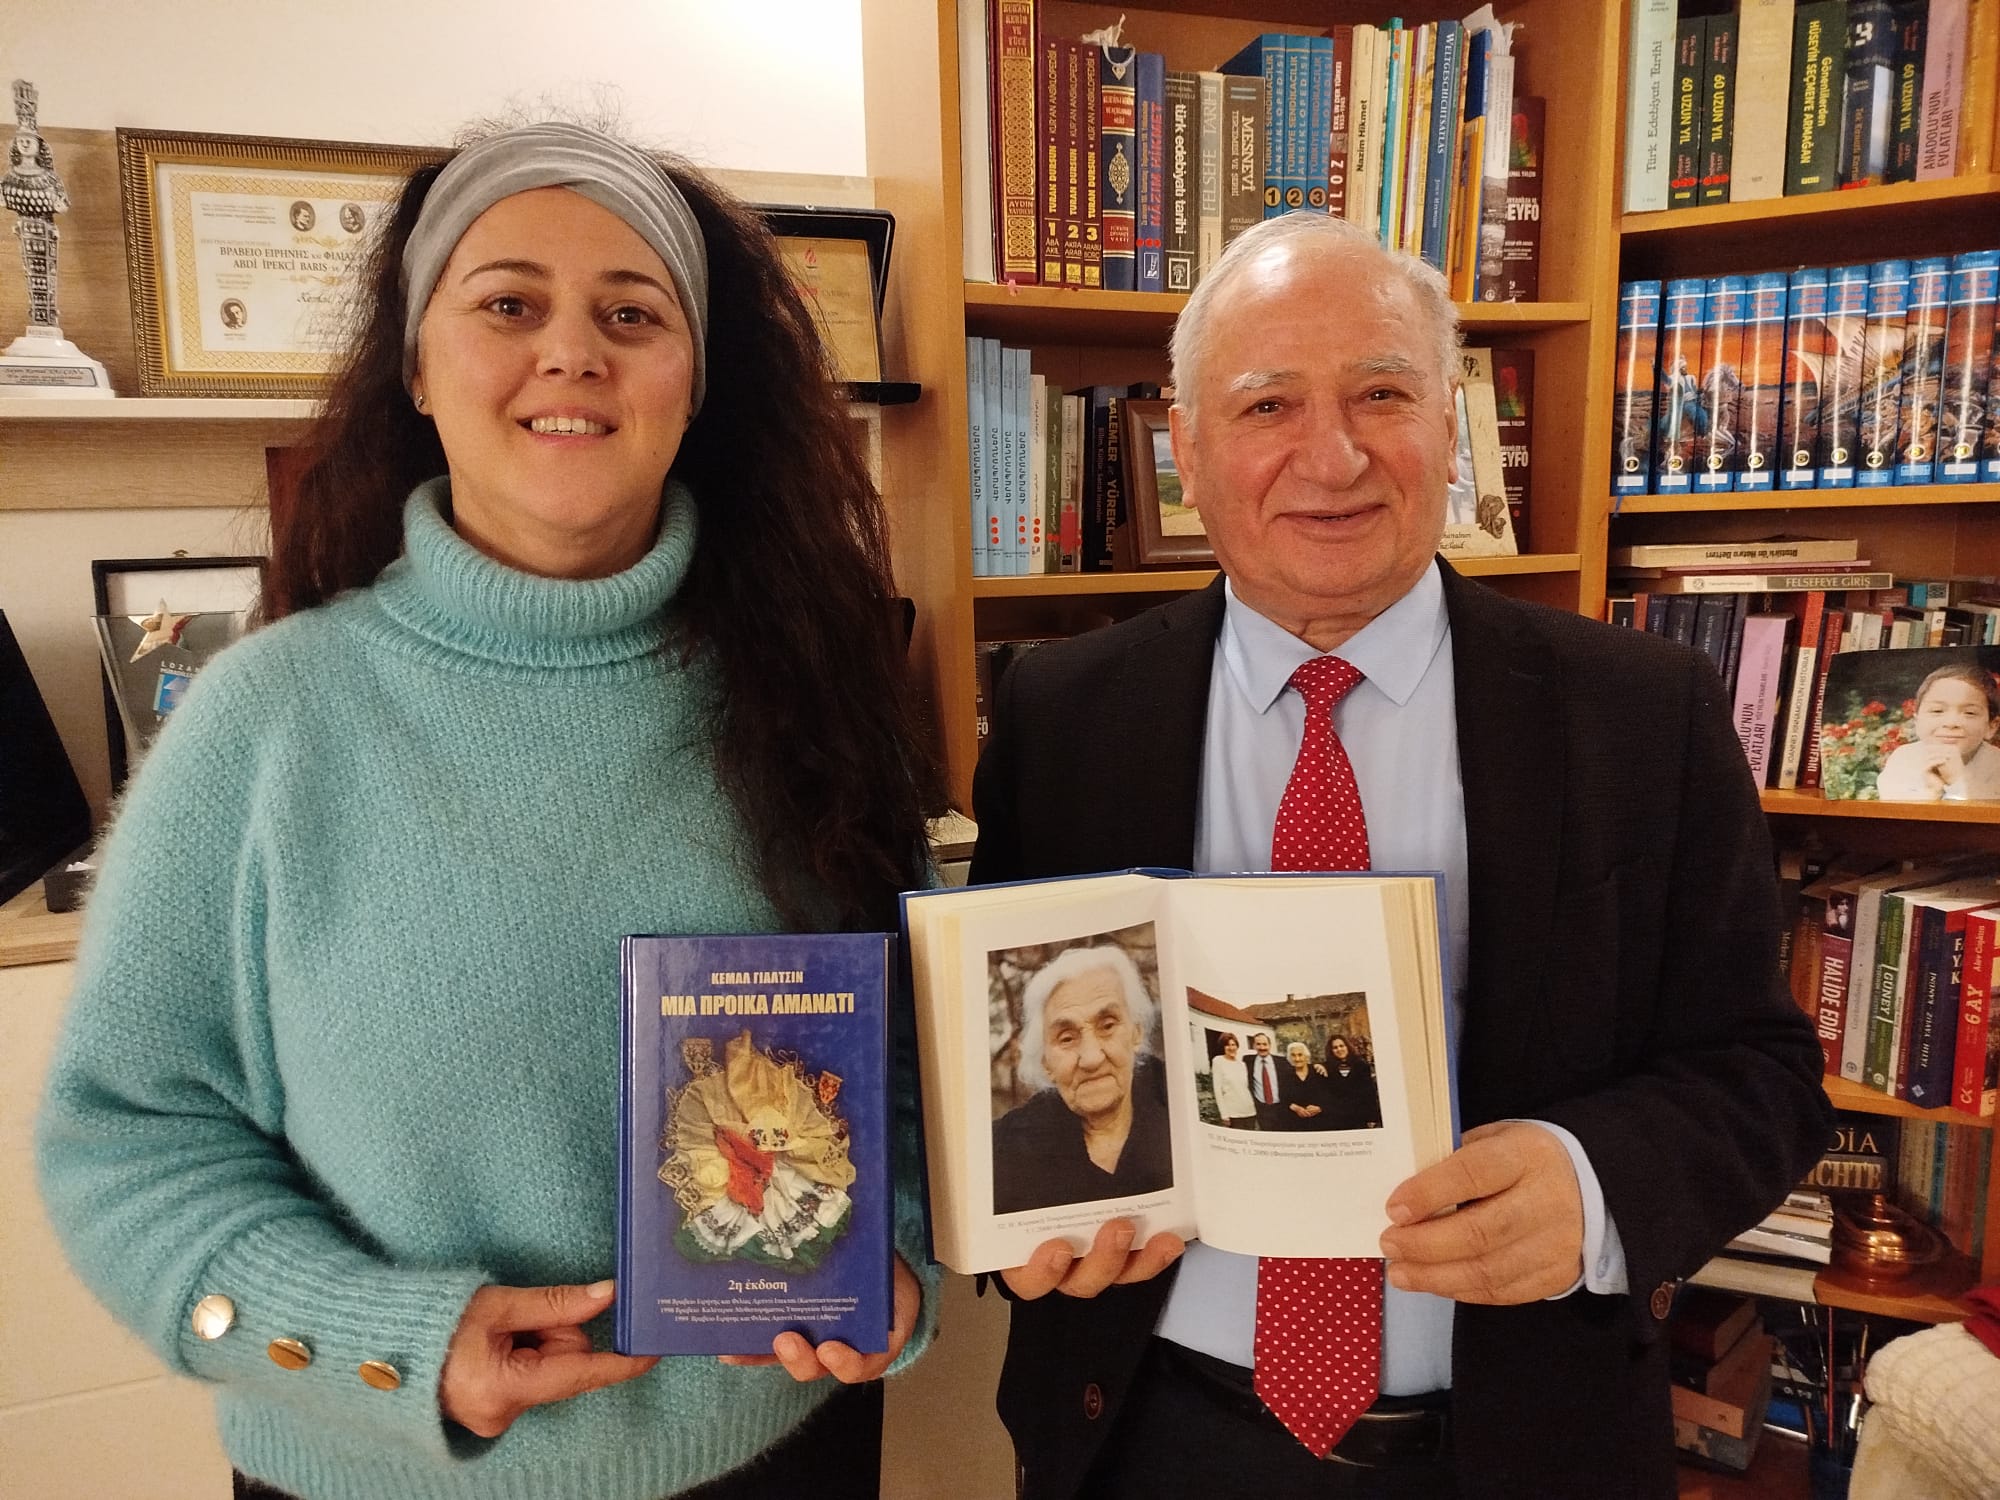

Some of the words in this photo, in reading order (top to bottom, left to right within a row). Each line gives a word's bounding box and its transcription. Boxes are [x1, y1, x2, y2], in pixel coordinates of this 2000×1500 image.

[1807, 20, 1821, 62] HÜSEYİN
[1650, 40, 1662, 77] Tarihi
[1903, 63, 1914, 79] 60
[1682, 77, 1693, 91] 60
[1714, 74, 1725, 89] 60
[1817, 57, 1832, 127] Gönenlilerden
[1901, 80, 1913, 112] UZUN
[1175, 104, 1187, 133] türk
[1358, 99, 1368, 137] Hikmet
[1680, 94, 1692, 125] UZUN
[1712, 91, 1724, 122] UZUN
[1679, 127, 1691, 145] YIL
[1711, 124, 1723, 143] YIL
[1899, 113, 1911, 132] YIL
[1924, 91, 1941, 170] ANADOLU'NUN
[1800, 113, 1814, 164] ARMAĞAN
[1937, 110, 1953, 168] EVLATLARI
[1048, 146, 1057, 181] DURSUN
[1069, 148, 1078, 184] DURSUN
[1087, 151, 1096, 187] DURSUN
[1173, 136, 1187, 197] edebiyatı
[1231, 158, 1239, 170] VE
[1646, 144, 1657, 173] Türk
[1203, 150, 1217, 212] FELSEFE
[1048, 184, 1057, 213] TURAN
[1069, 187, 1078, 215] TURAN
[1087, 189, 1096, 218] TURAN
[1269, 189, 1277, 205] 1
[1289, 189, 1300, 205] 2
[1311, 190, 1323, 205] 3
[1048, 222, 1055, 236] 1
[1068, 225, 1079, 238] 2
[1175, 200, 1187, 234] tarihi
[1087, 227, 1098, 241] 3
[220, 247, 262, 257] ΒΡΑΒΕΙΟ
[265, 248, 309, 259] ΕΙΡΗΝΗΣ
[1107, 397, 1118, 462] KALEMLER
[1500, 450, 1529, 468] EYFO
[1105, 479, 1119, 552] YÜREKLER
[1785, 577, 1838, 587] FELSEFEYE
[1841, 576, 1871, 588] GİRİŞ
[1751, 724, 1767, 772] EVLATLARI
[712, 973, 750, 985] ΚΕΜΑΛ
[754, 971, 803, 984] ΓΙΑΛΤΣΙΝ
[1821, 957, 1847, 1007] HALİDE
[661, 995, 697, 1016] ΜΙΑ
[700, 994, 769, 1015] ΠΡΟΙΚΑ
[771, 993, 855, 1014] ΑΜΑΝΑΤΙ
[1965, 984, 1984, 1013] AY
[1818, 1008, 1842, 1041] EDİB
[1923, 1011, 1934, 1038] YAVUZ
[1964, 1014, 1981, 1024] 6
[728, 1279, 742, 1293] 2η
[745, 1279, 788, 1293] έκδοση
